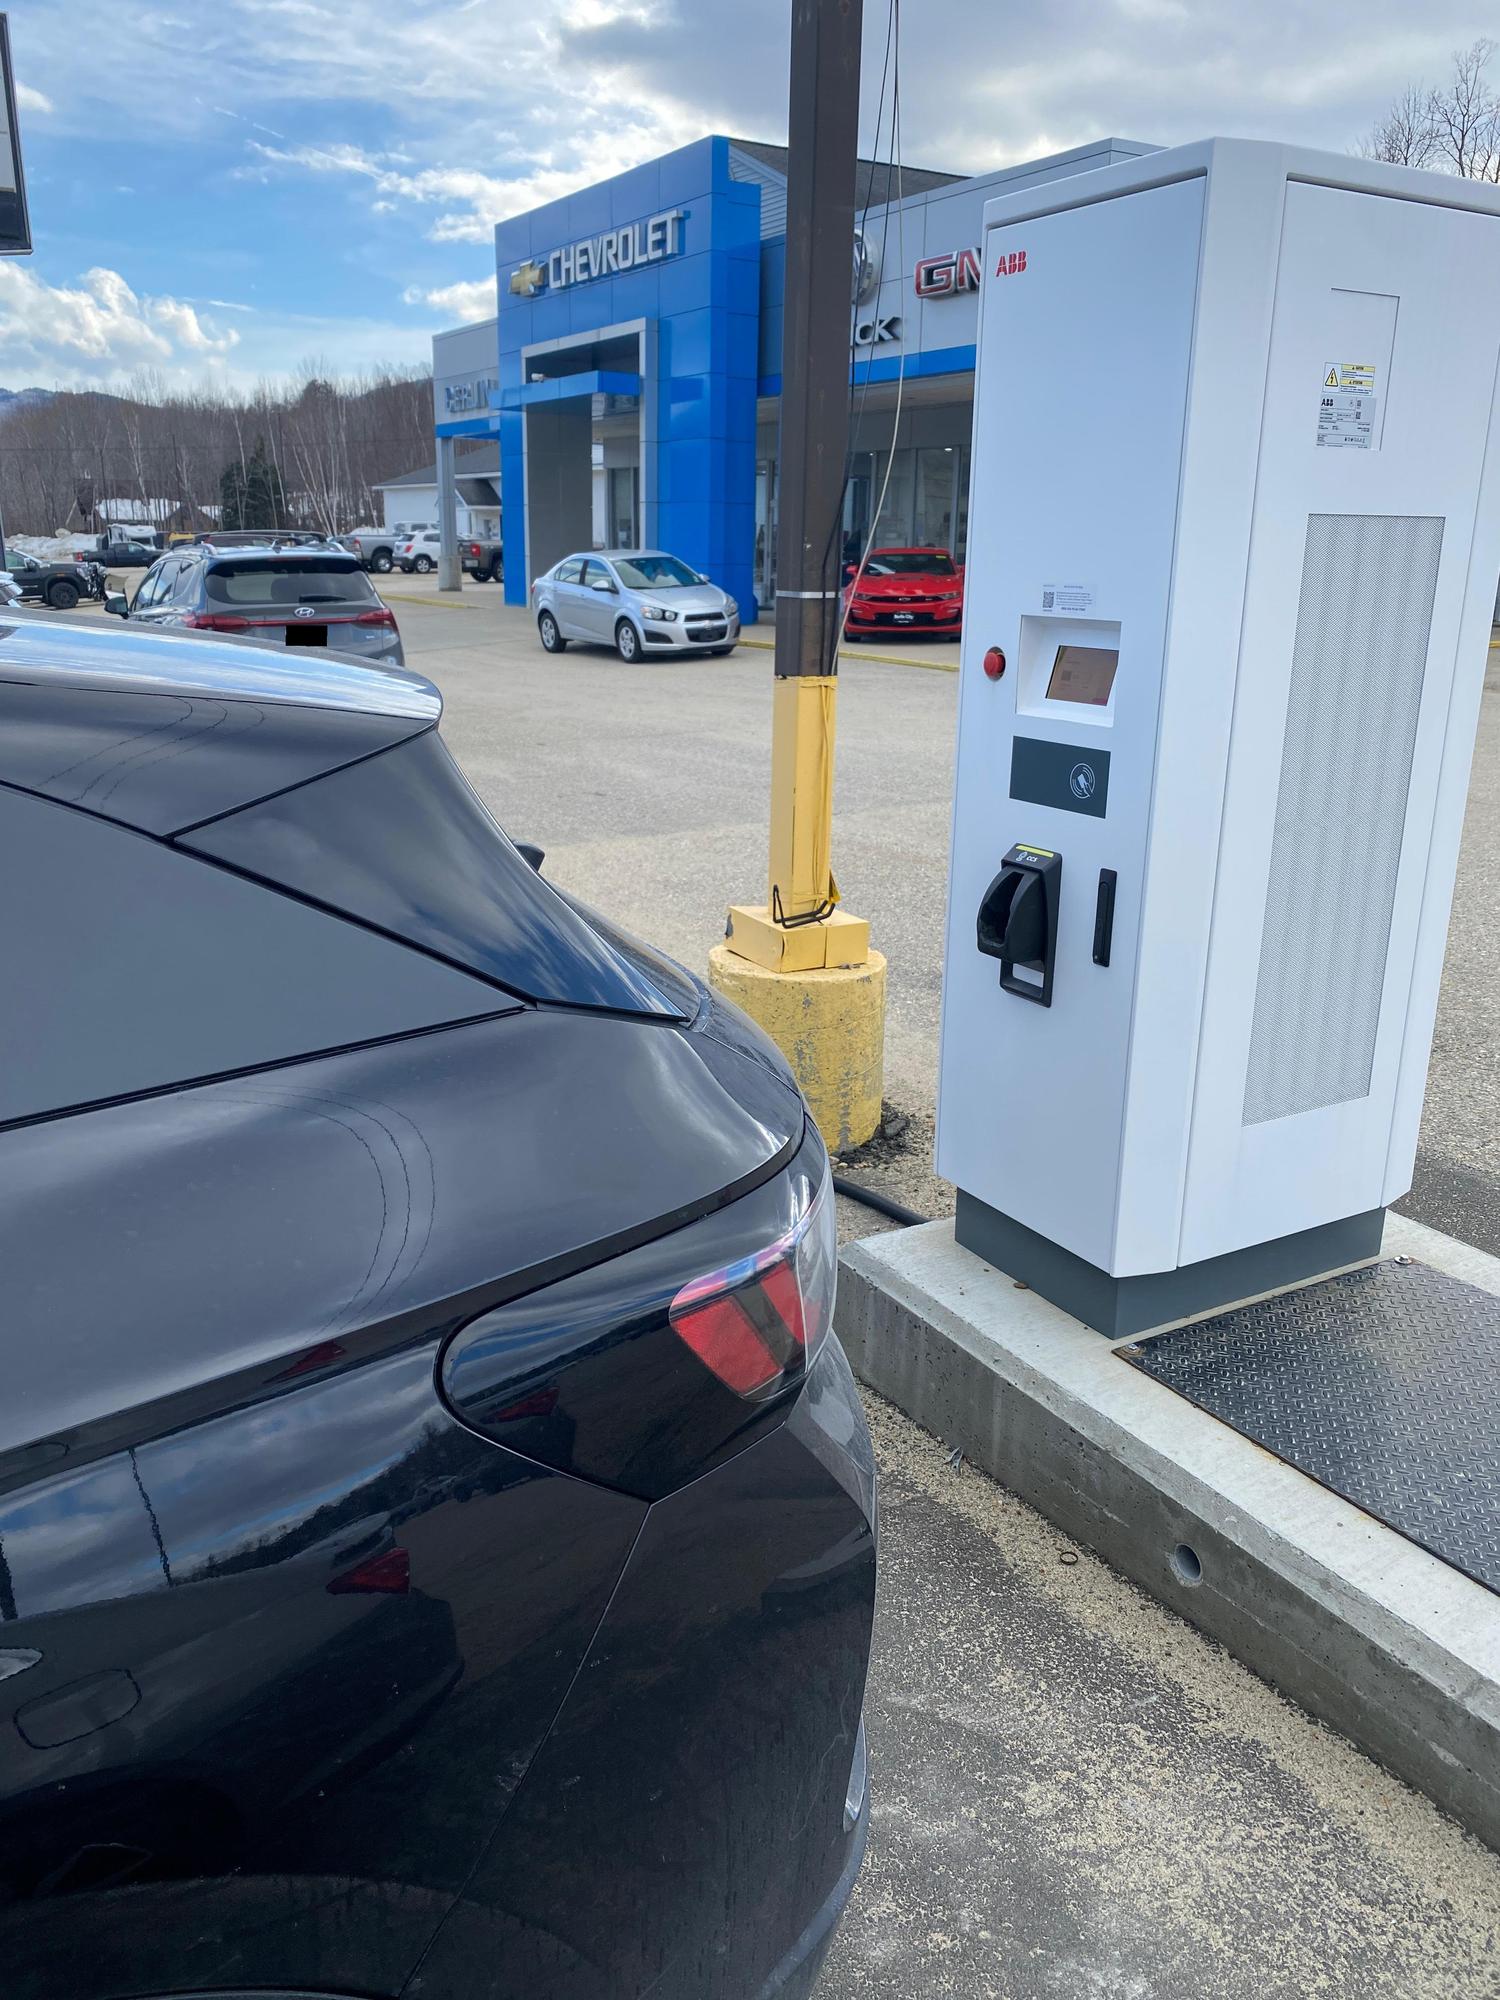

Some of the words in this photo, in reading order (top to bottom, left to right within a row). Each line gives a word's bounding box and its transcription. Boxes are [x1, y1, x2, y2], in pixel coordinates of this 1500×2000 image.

[550, 208, 685, 289] CHEVROLET
[996, 251, 1027, 277] ABB
[914, 247, 981, 298] GM
[850, 316, 901, 347] ICK
[1321, 398, 1334, 406] ABB
